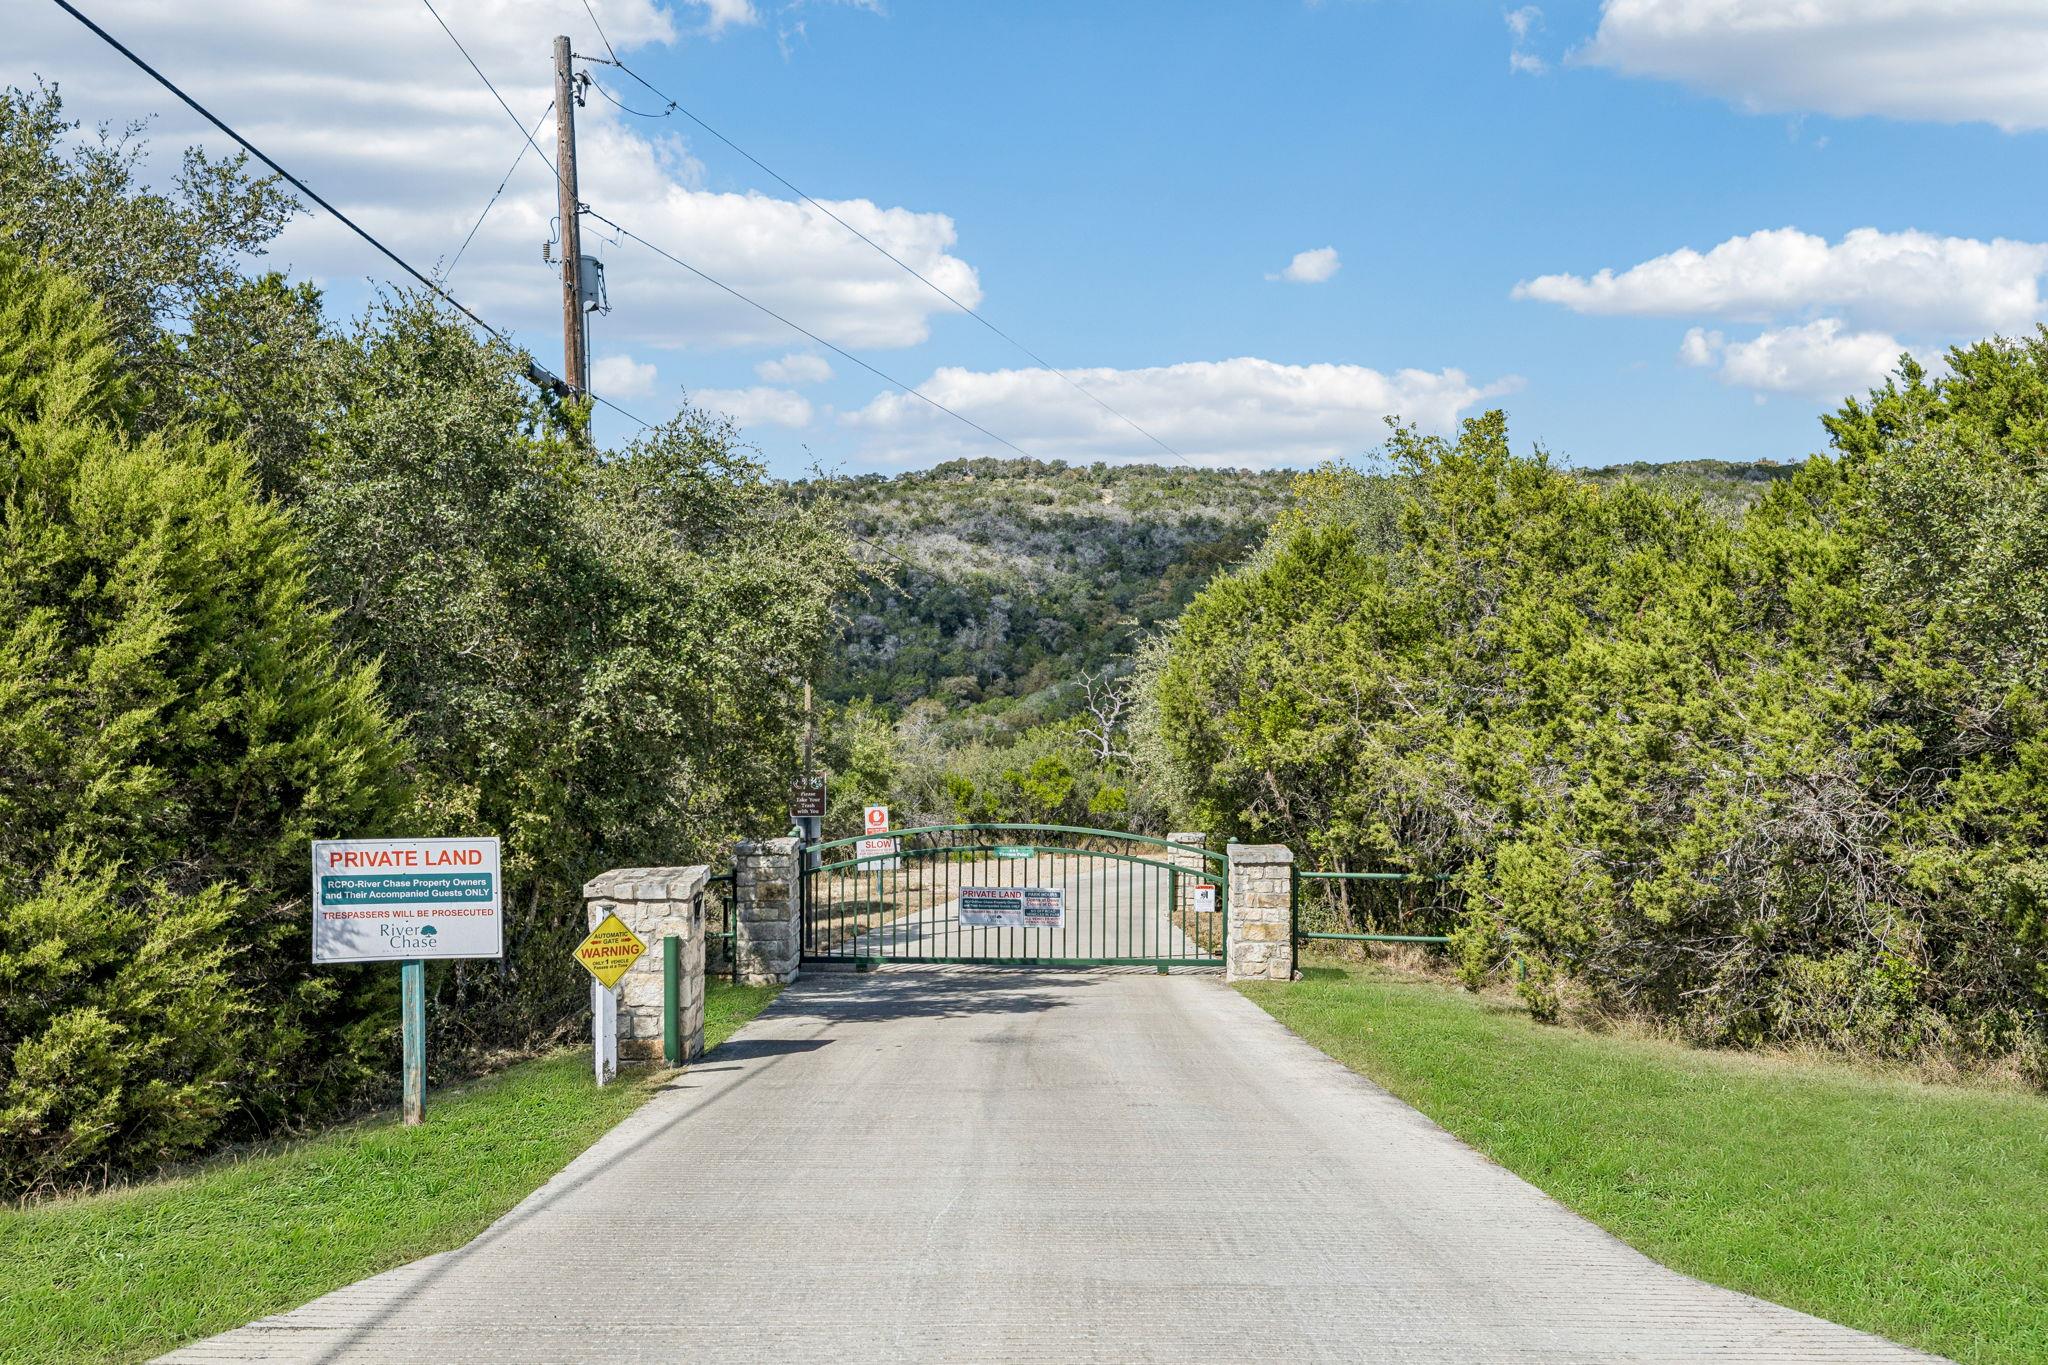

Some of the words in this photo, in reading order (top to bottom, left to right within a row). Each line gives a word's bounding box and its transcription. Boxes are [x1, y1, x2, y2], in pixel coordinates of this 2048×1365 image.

[865, 840, 892, 848] SLOW
[330, 850, 418, 868] PRIVATE
[425, 850, 482, 866] LAND
[328, 880, 380, 888] RCPO-River
[383, 880, 410, 888] Chase
[413, 879, 450, 888] Property
[452, 878, 486, 886] Owners
[326, 892, 342, 900] and
[344, 891, 367, 899] Their
[369, 890, 429, 900] Accompanied
[432, 889, 462, 898] Guests
[465, 888, 490, 896] ONLY
[323, 911, 390, 920] TRESPASSERS
[432, 909, 494, 917] PROSECUTED
[380, 924, 420, 936] River
[390, 935, 436, 948] Chase
[581, 944, 640, 958] WARNING
